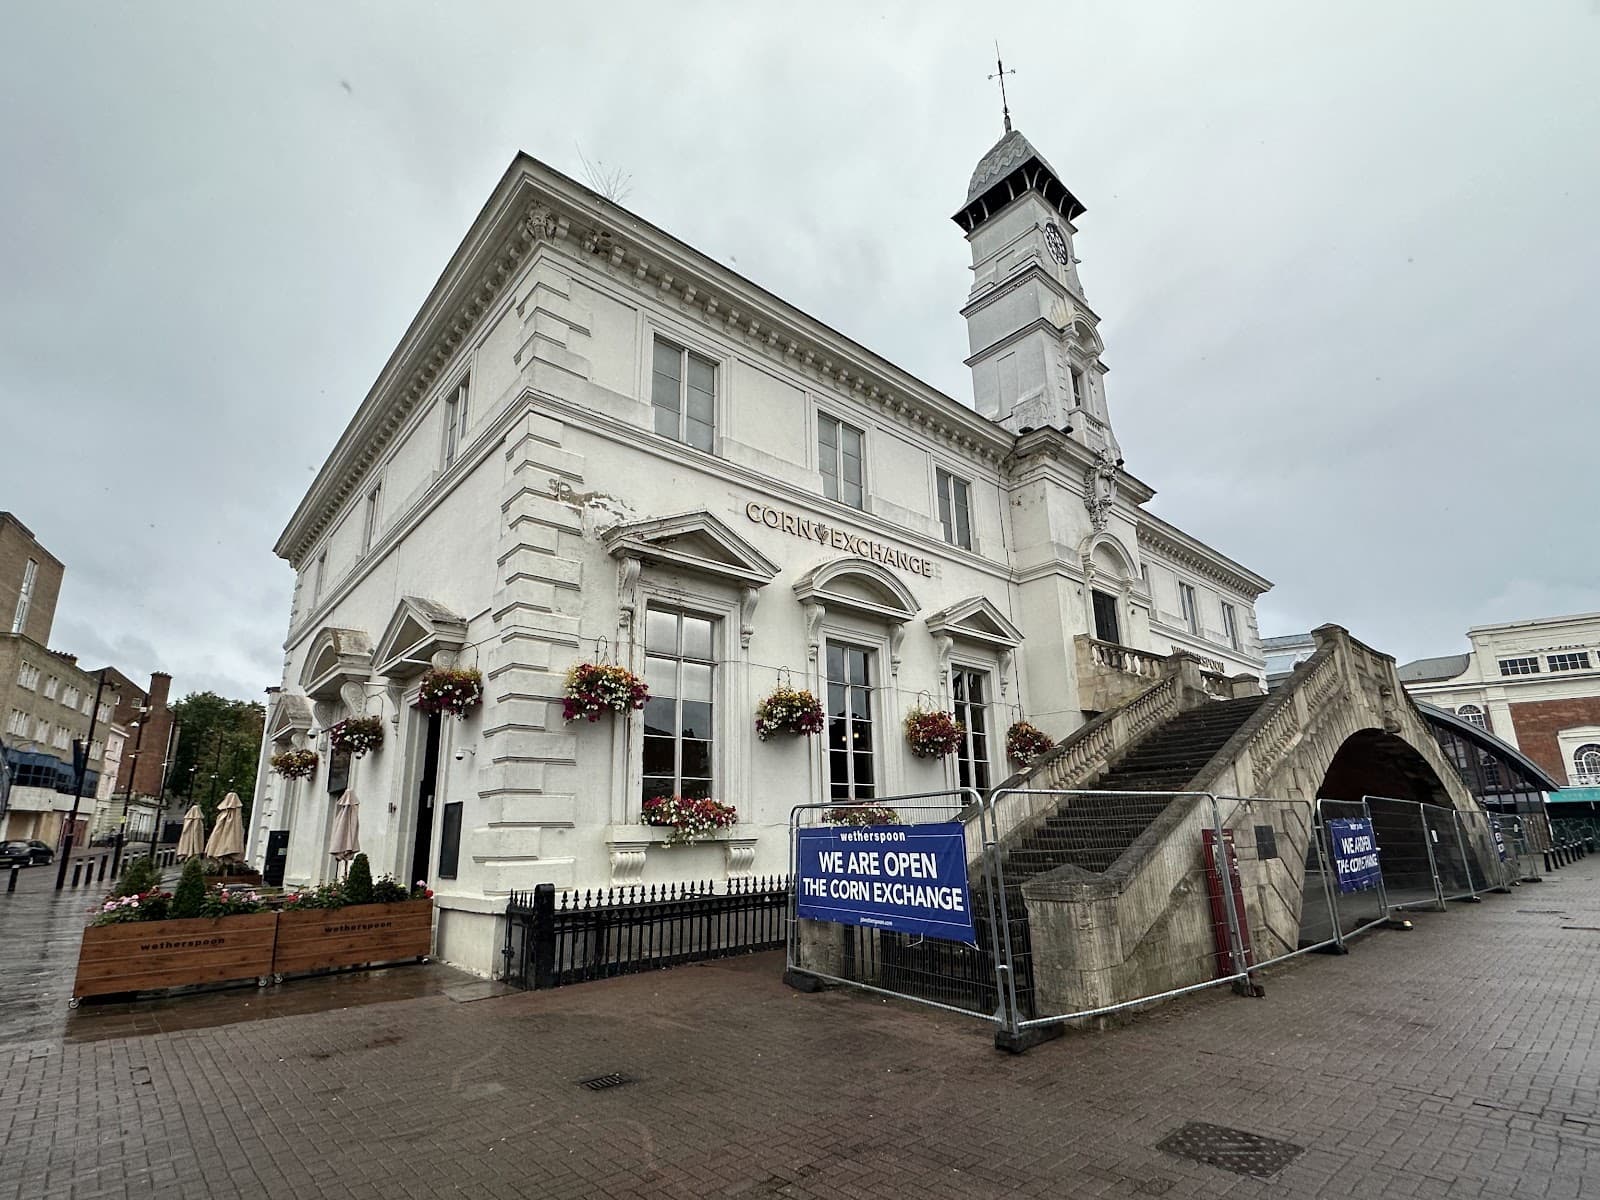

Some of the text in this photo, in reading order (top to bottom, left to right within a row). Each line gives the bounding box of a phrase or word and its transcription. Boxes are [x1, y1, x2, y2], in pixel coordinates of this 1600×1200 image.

[746, 502, 932, 578] CORN EXCHANGE
[840, 831, 906, 844] wetherspoon
[819, 851, 938, 879] WE ARE OPEN
[803, 877, 964, 912] THE CORN EXCHANGE
[324, 921, 392, 933] wetherspoon
[140, 938, 225, 951] wetherspoon
